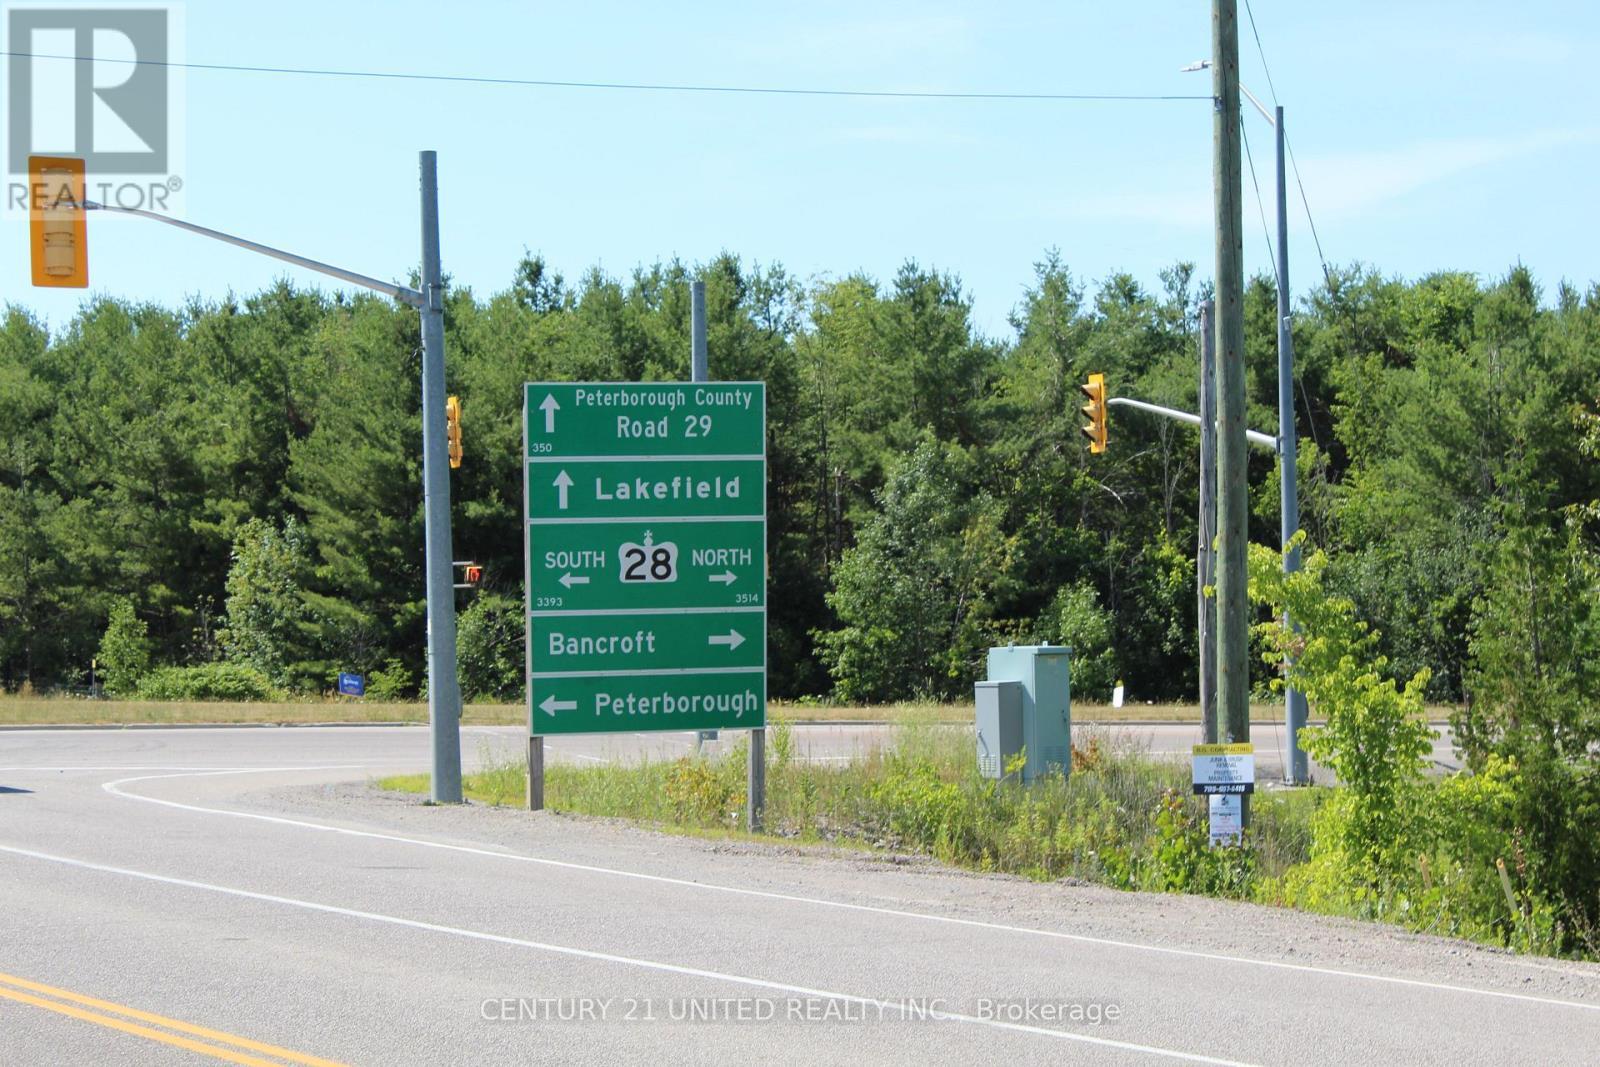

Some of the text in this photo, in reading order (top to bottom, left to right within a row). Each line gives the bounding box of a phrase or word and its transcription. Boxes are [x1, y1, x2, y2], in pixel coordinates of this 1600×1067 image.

[576, 388, 752, 411] Peterborough County
[617, 414, 712, 438] Road 29
[532, 443, 552, 453] 350
[596, 476, 740, 500] Lakefield
[545, 551, 605, 569] SOUTH
[624, 548, 672, 581] 28
[692, 548, 752, 567] NORTH
[536, 597, 563, 607] 3393
[735, 593, 759, 604] 3514
[549, 631, 656, 656] Bancroft
[595, 690, 758, 719] Peterborough
